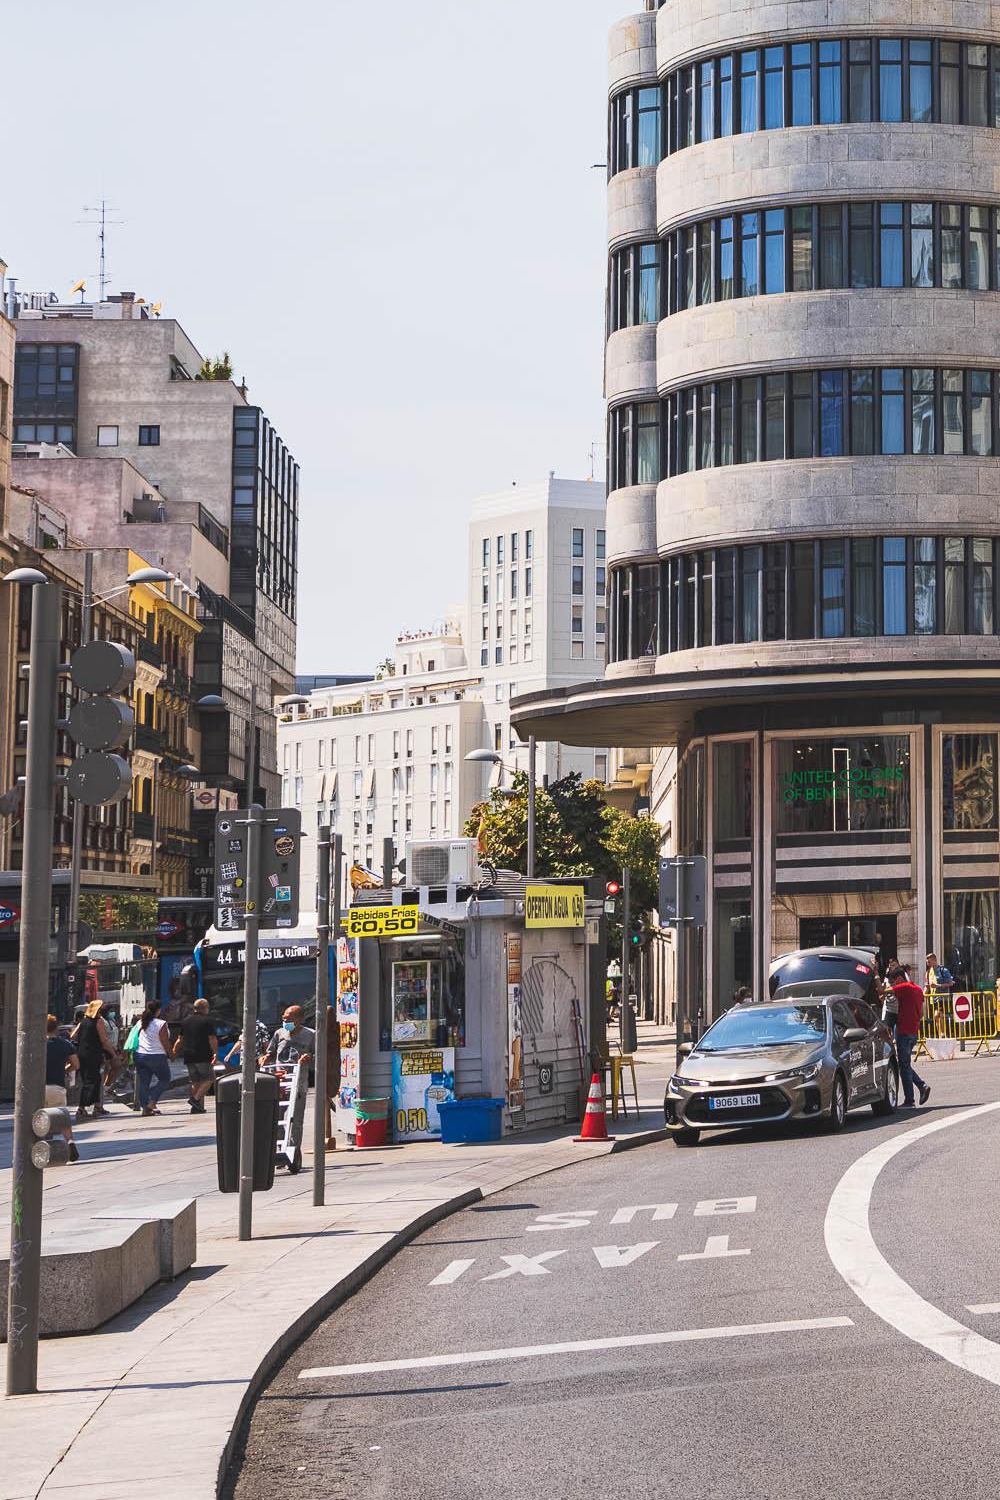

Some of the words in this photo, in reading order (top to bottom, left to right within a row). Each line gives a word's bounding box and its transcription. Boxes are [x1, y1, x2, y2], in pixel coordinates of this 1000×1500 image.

[783, 770, 835, 785] UNITED
[840, 767, 903, 783] COLORS
[783, 787, 803, 803] OF
[527, 888, 553, 919] OFERTÓN
[553, 895, 569, 919] AGUA
[350, 911, 390, 921] Bebidas
[391, 907, 417, 918] Frías
[350, 918, 417, 934] €0,50
[217, 949, 232, 964] 44
[715, 1096, 739, 1108] 9069
[740, 1094, 759, 1106] LRN
[525, 1196, 758, 1232] BUS
[427, 1235, 752, 1286] TAXI
